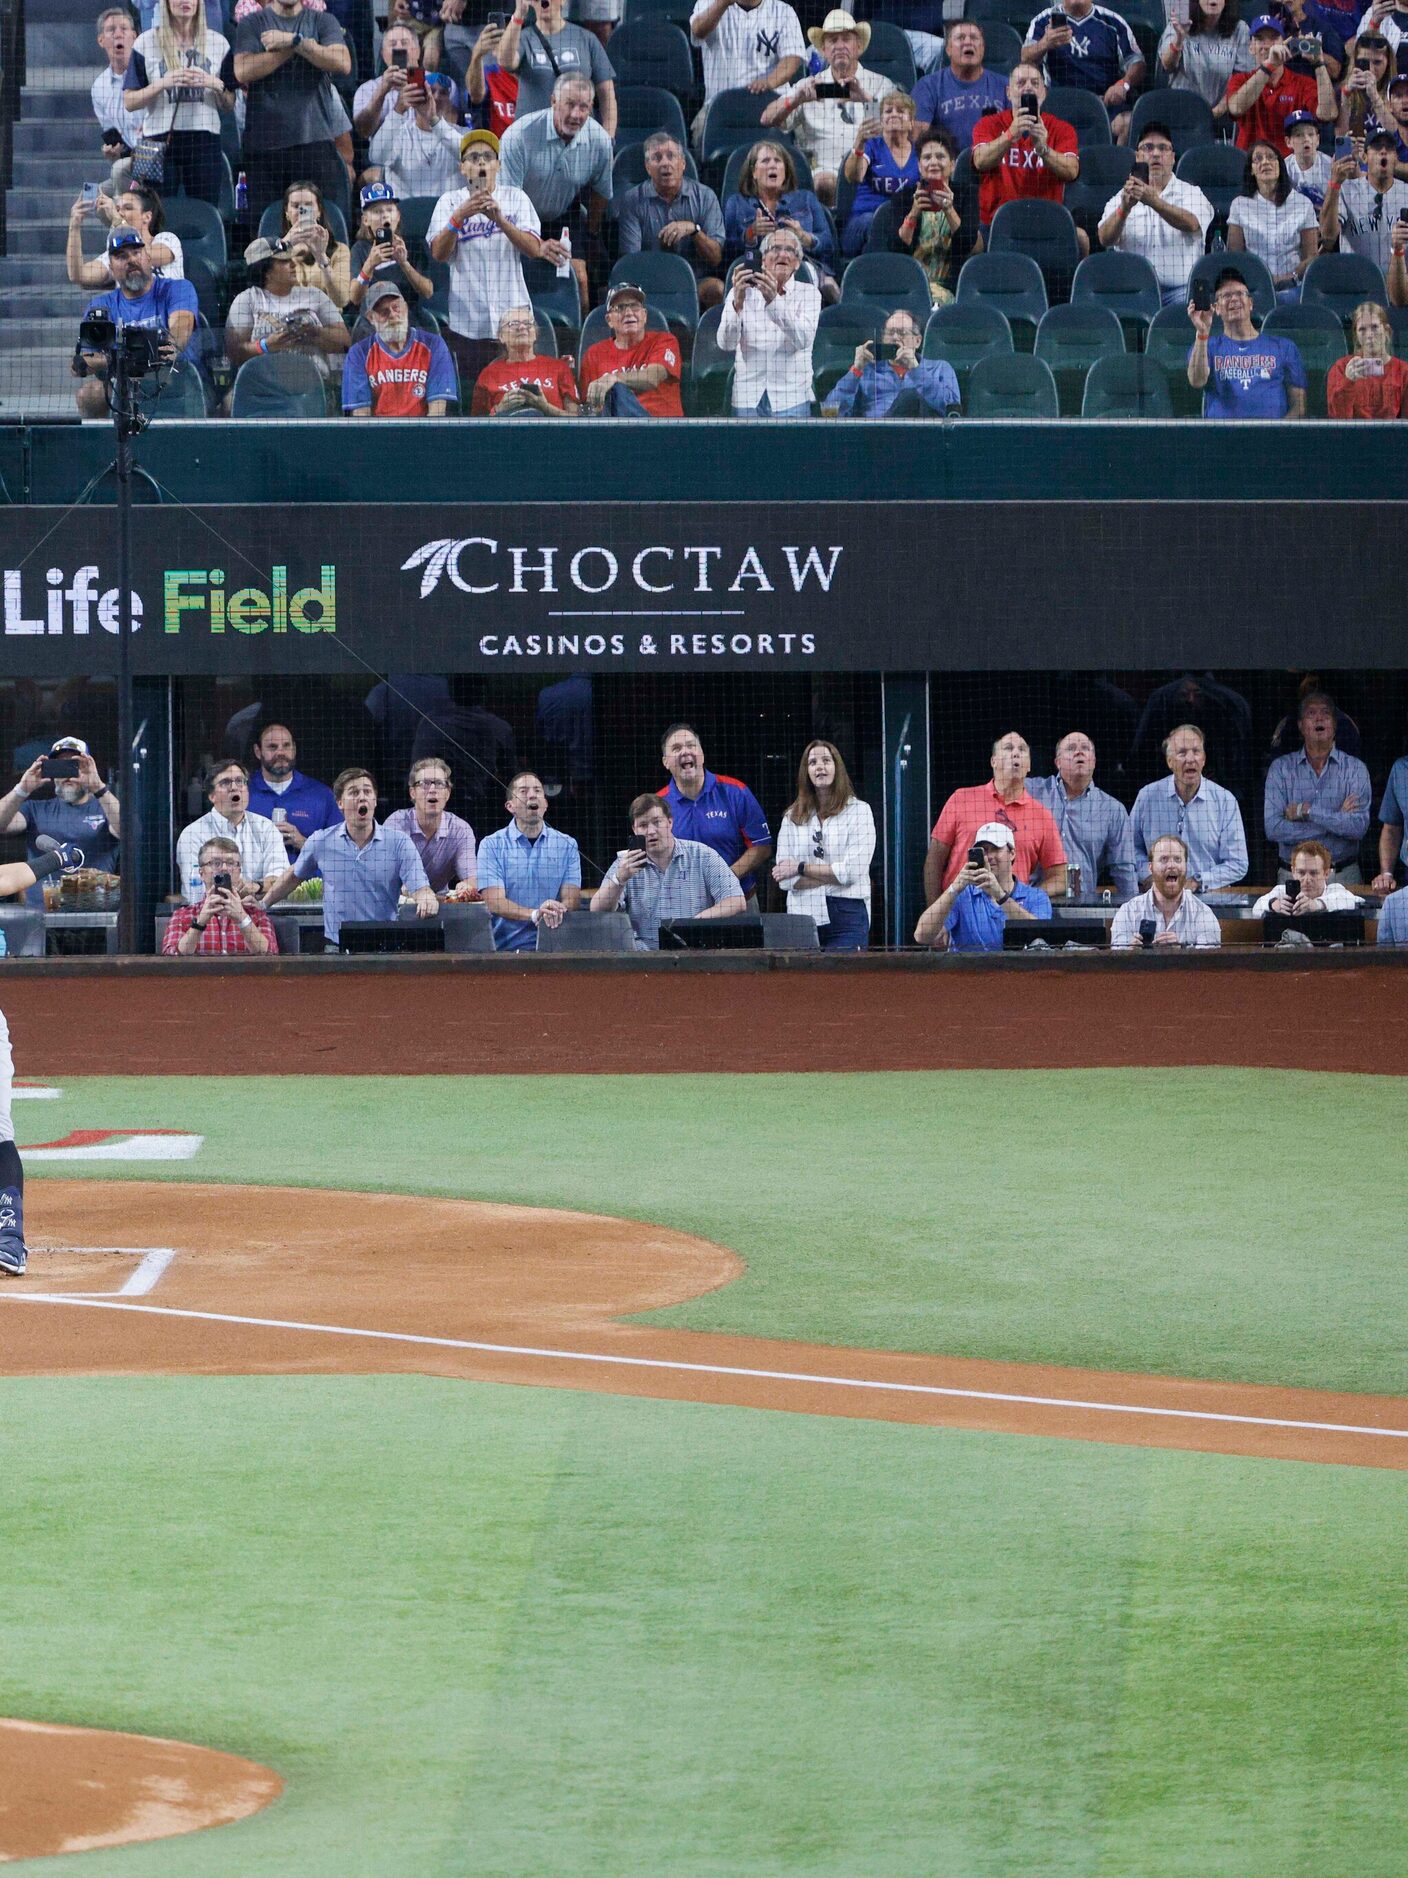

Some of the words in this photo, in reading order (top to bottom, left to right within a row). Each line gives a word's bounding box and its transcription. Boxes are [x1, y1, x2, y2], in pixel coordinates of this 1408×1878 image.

[1259, 14, 1271, 24] T
[756, 28, 779, 57] NY
[1070, 35, 1091, 57] NY
[1292, 109, 1303, 120] T
[872, 176, 909, 193] TEX
[1214, 354, 1277, 372] RANGERS
[368, 368, 428, 388] RANGERS
[1239, 379, 1252, 391] T
[446, 536, 844, 594] CHOCTAW
[3, 565, 144, 635] Life
[163, 565, 337, 634] Field
[479, 633, 626, 656] CASINOS
[638, 633, 658, 655] &
[670, 632, 817, 656] RESORTS
[705, 810, 728, 819] TEXAS
